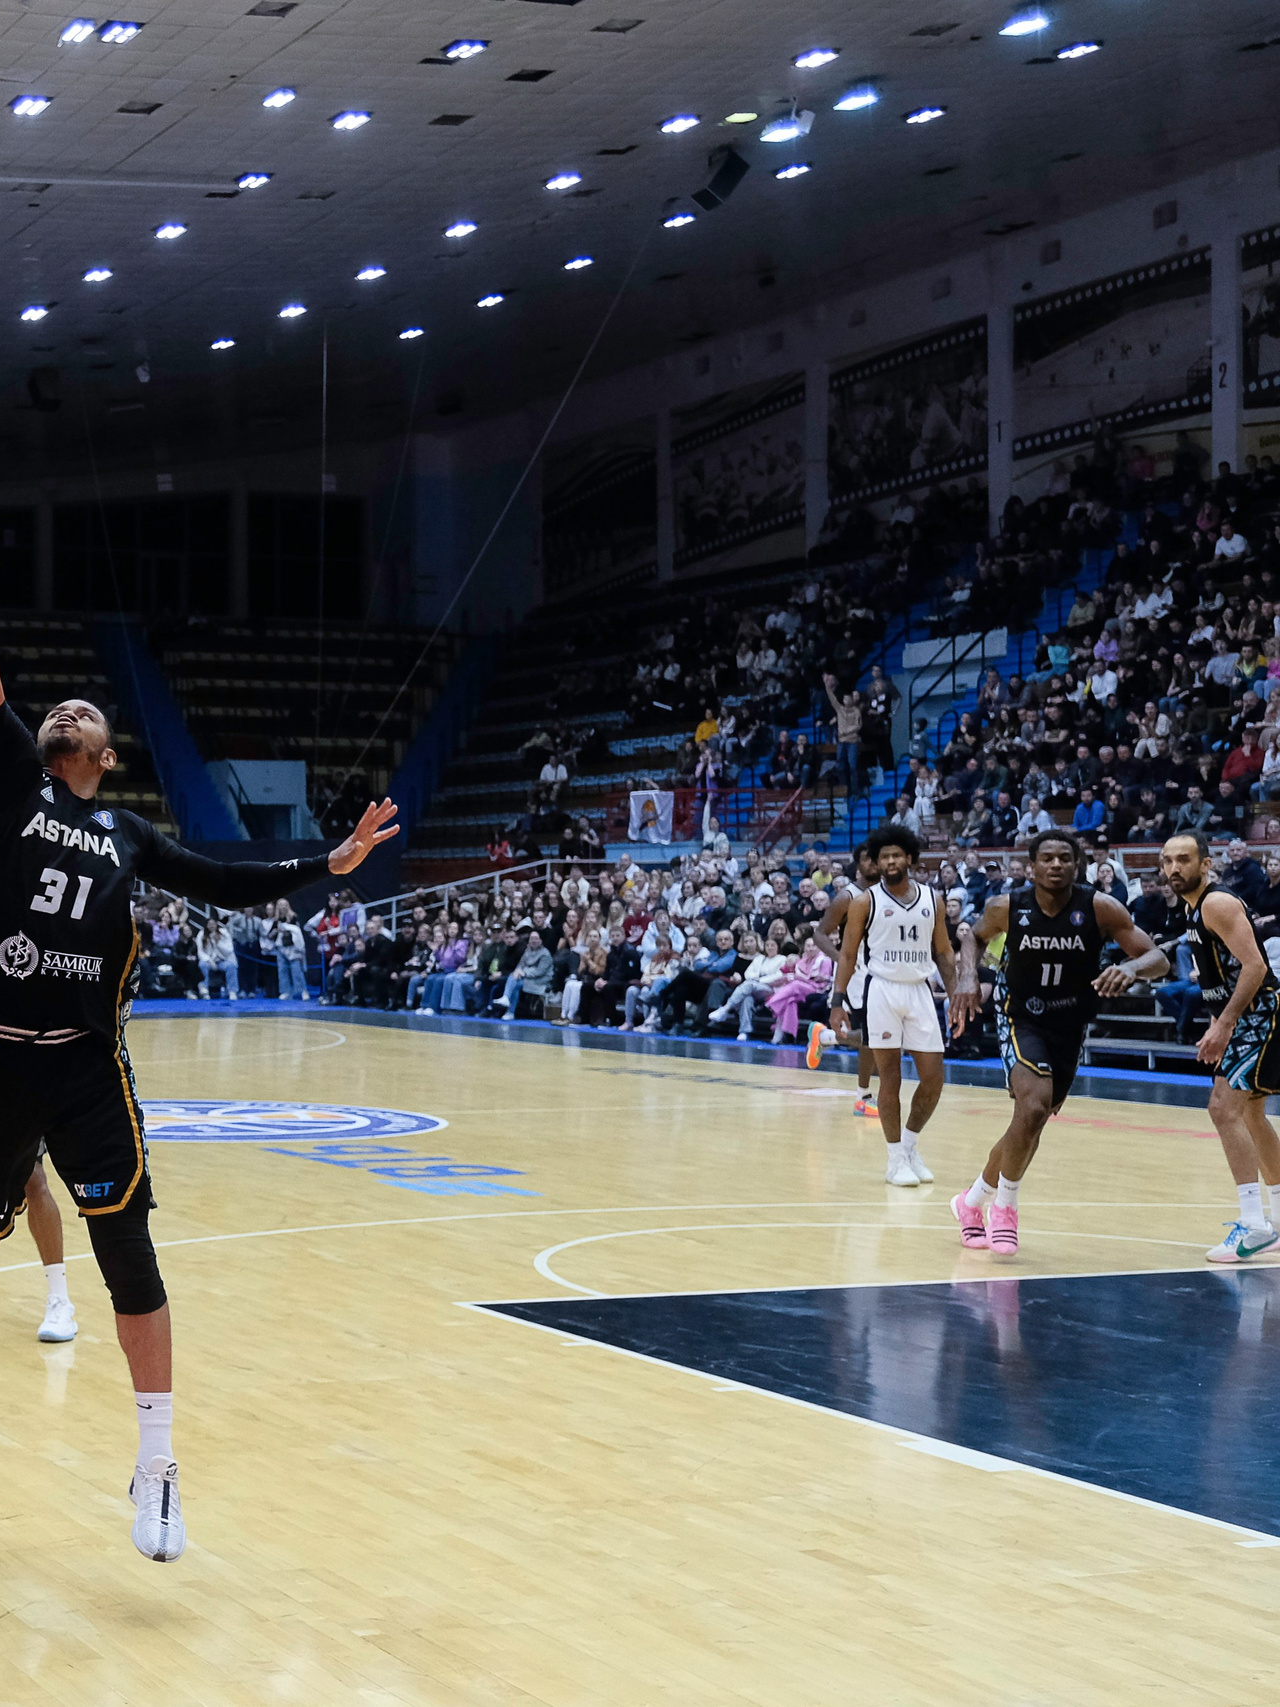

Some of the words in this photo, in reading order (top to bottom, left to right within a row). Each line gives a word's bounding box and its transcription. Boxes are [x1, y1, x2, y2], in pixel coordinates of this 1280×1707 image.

[1218, 361, 1228, 389] 2
[21, 811, 120, 867] ASTANA
[30, 867, 94, 920] 31
[898, 924, 920, 942] 14
[1019, 934, 1085, 951] ASTANA
[41, 952, 104, 973] SAMRUK
[40, 967, 101, 983] KAZYNA
[1040, 963, 1063, 987] 11
